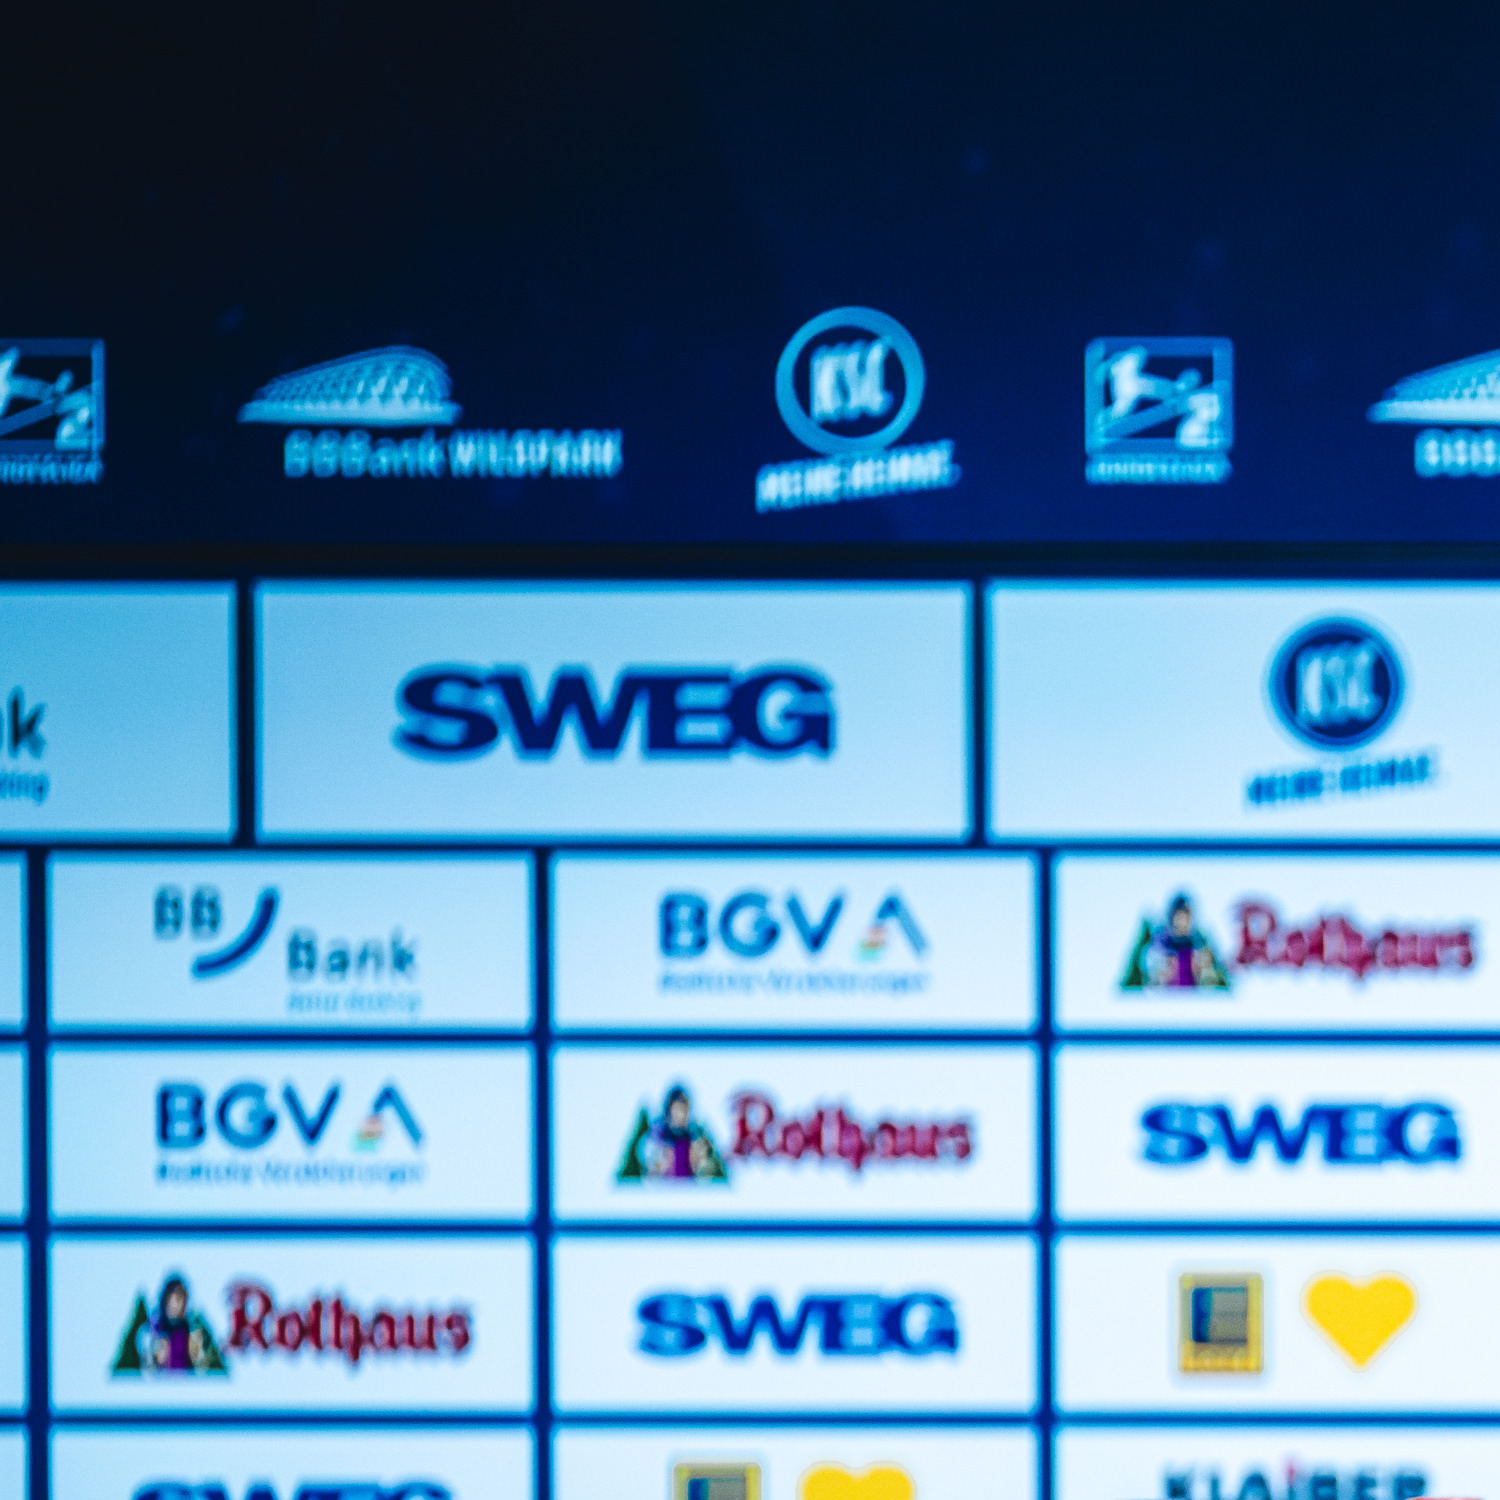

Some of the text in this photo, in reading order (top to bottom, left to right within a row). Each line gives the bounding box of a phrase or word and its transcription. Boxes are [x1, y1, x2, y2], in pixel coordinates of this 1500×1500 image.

[397, 661, 837, 761] SWEG
[287, 927, 418, 981] Bank
[1138, 1099, 1463, 1166] SWEG
[225, 1281, 474, 1368] Rothaus
[635, 1287, 959, 1357] SWEG
